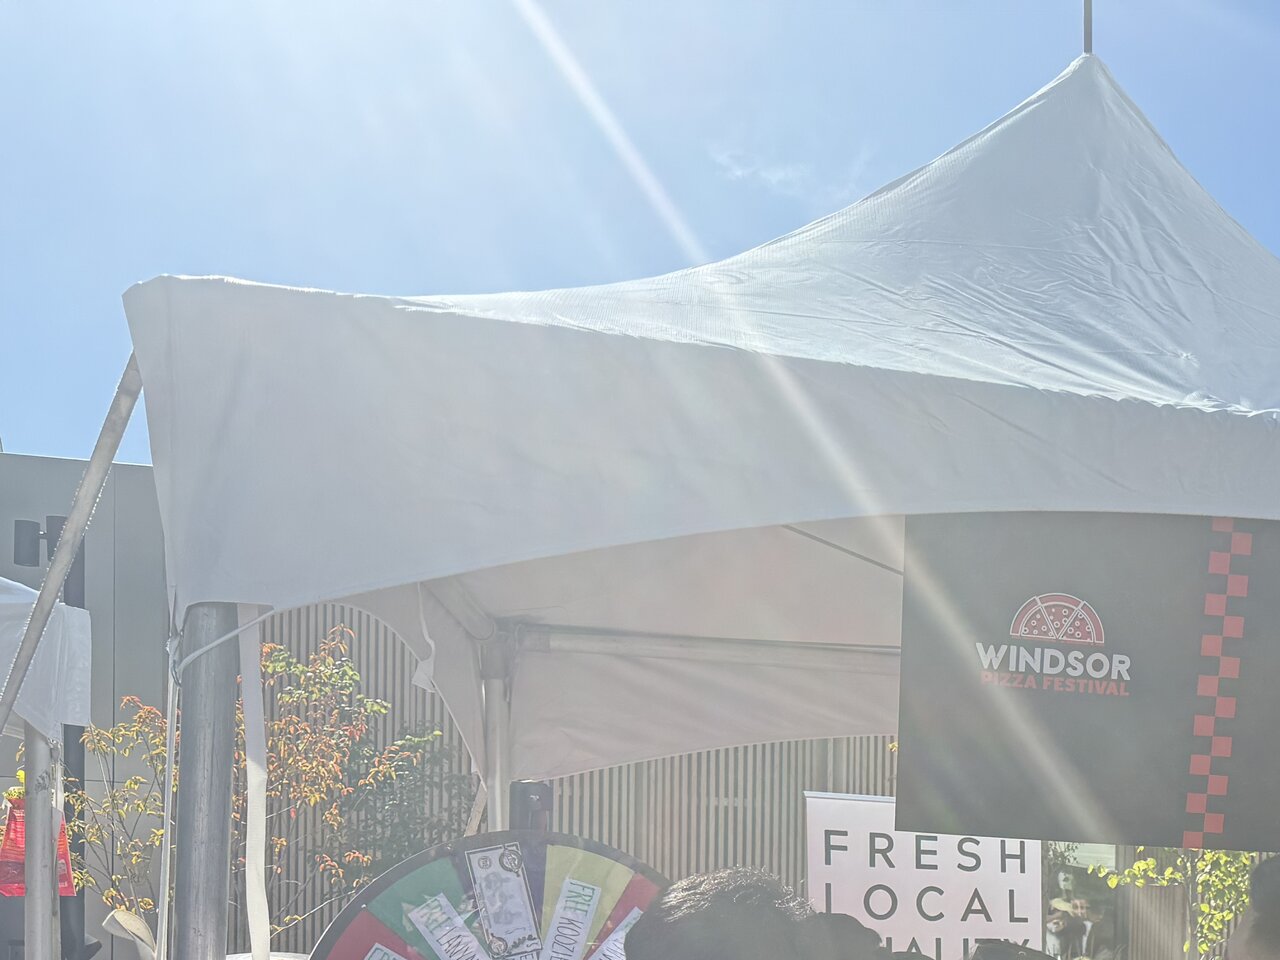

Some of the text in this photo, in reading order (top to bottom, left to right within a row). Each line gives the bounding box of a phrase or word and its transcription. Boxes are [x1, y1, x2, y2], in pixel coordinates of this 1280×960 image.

[975, 642, 1131, 680] WINDSOR
[980, 669, 1130, 696] PIZZA FESTIVAL
[824, 829, 1026, 874] FRESH
[570, 880, 601, 917] FREE
